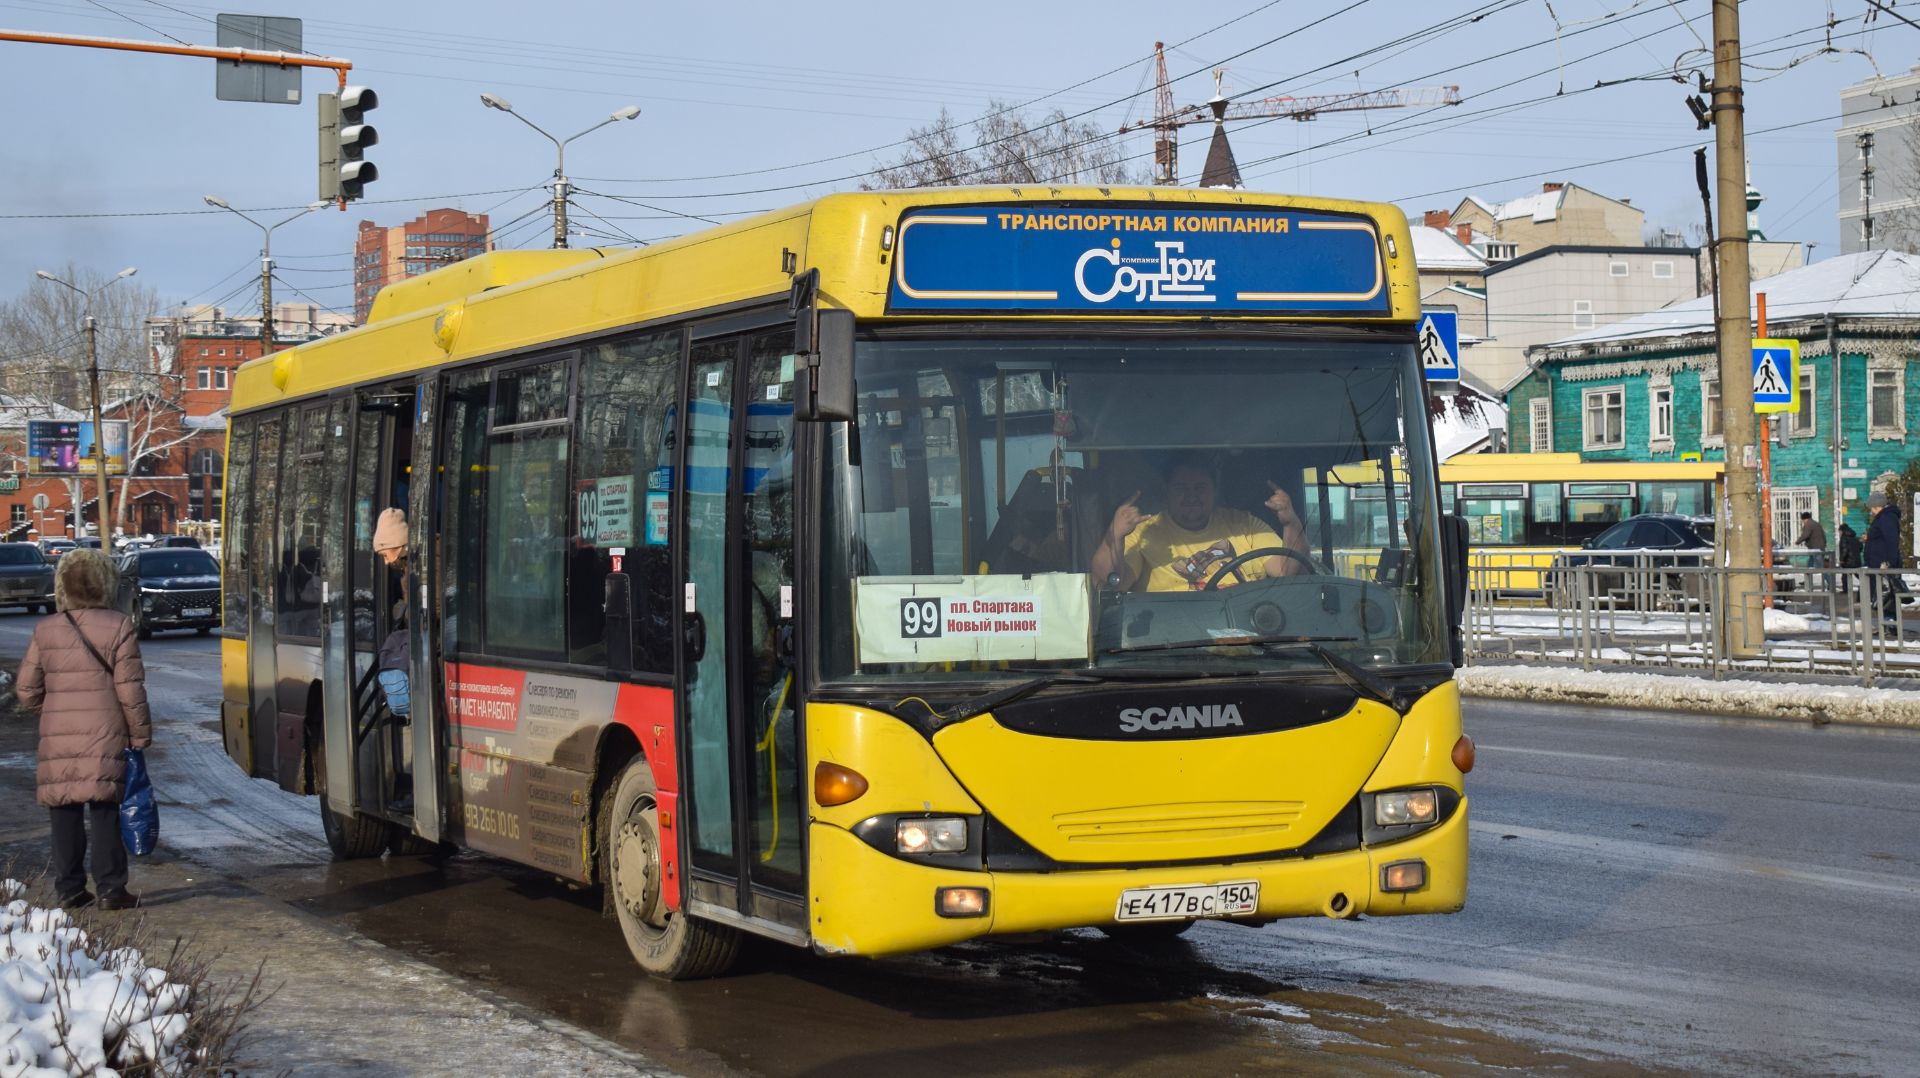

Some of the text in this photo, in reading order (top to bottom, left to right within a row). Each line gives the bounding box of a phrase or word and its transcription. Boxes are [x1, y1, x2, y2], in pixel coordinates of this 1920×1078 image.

[998, 214, 1289, 233] ТРАНСПОРТНАЯ КОМПАНИЯ
[950, 600, 1034, 614] пл. Спартака
[904, 601, 938, 635] 99
[947, 618, 1036, 632] Новый рынок
[477, 699, 487, 717] НА
[1119, 703, 1244, 733] SCANIA
[465, 803, 520, 840] 913 266 10 06
[1219, 886, 1250, 904] 150
